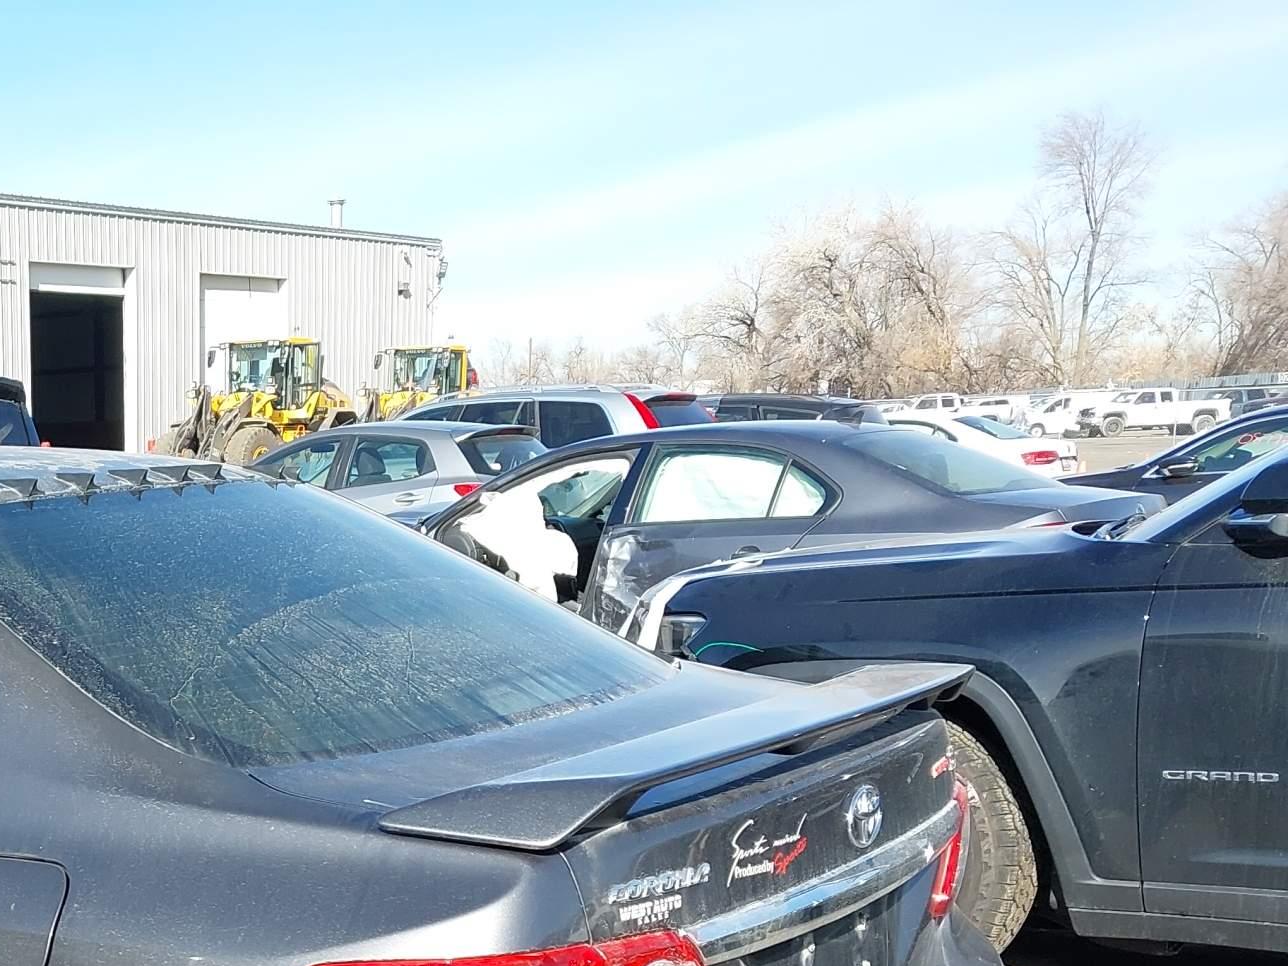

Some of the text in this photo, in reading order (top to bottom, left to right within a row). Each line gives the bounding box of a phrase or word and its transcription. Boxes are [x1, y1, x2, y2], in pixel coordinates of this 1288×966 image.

[1162, 770, 1279, 783] GRAND
[620, 896, 682, 922] WEST AUTO
